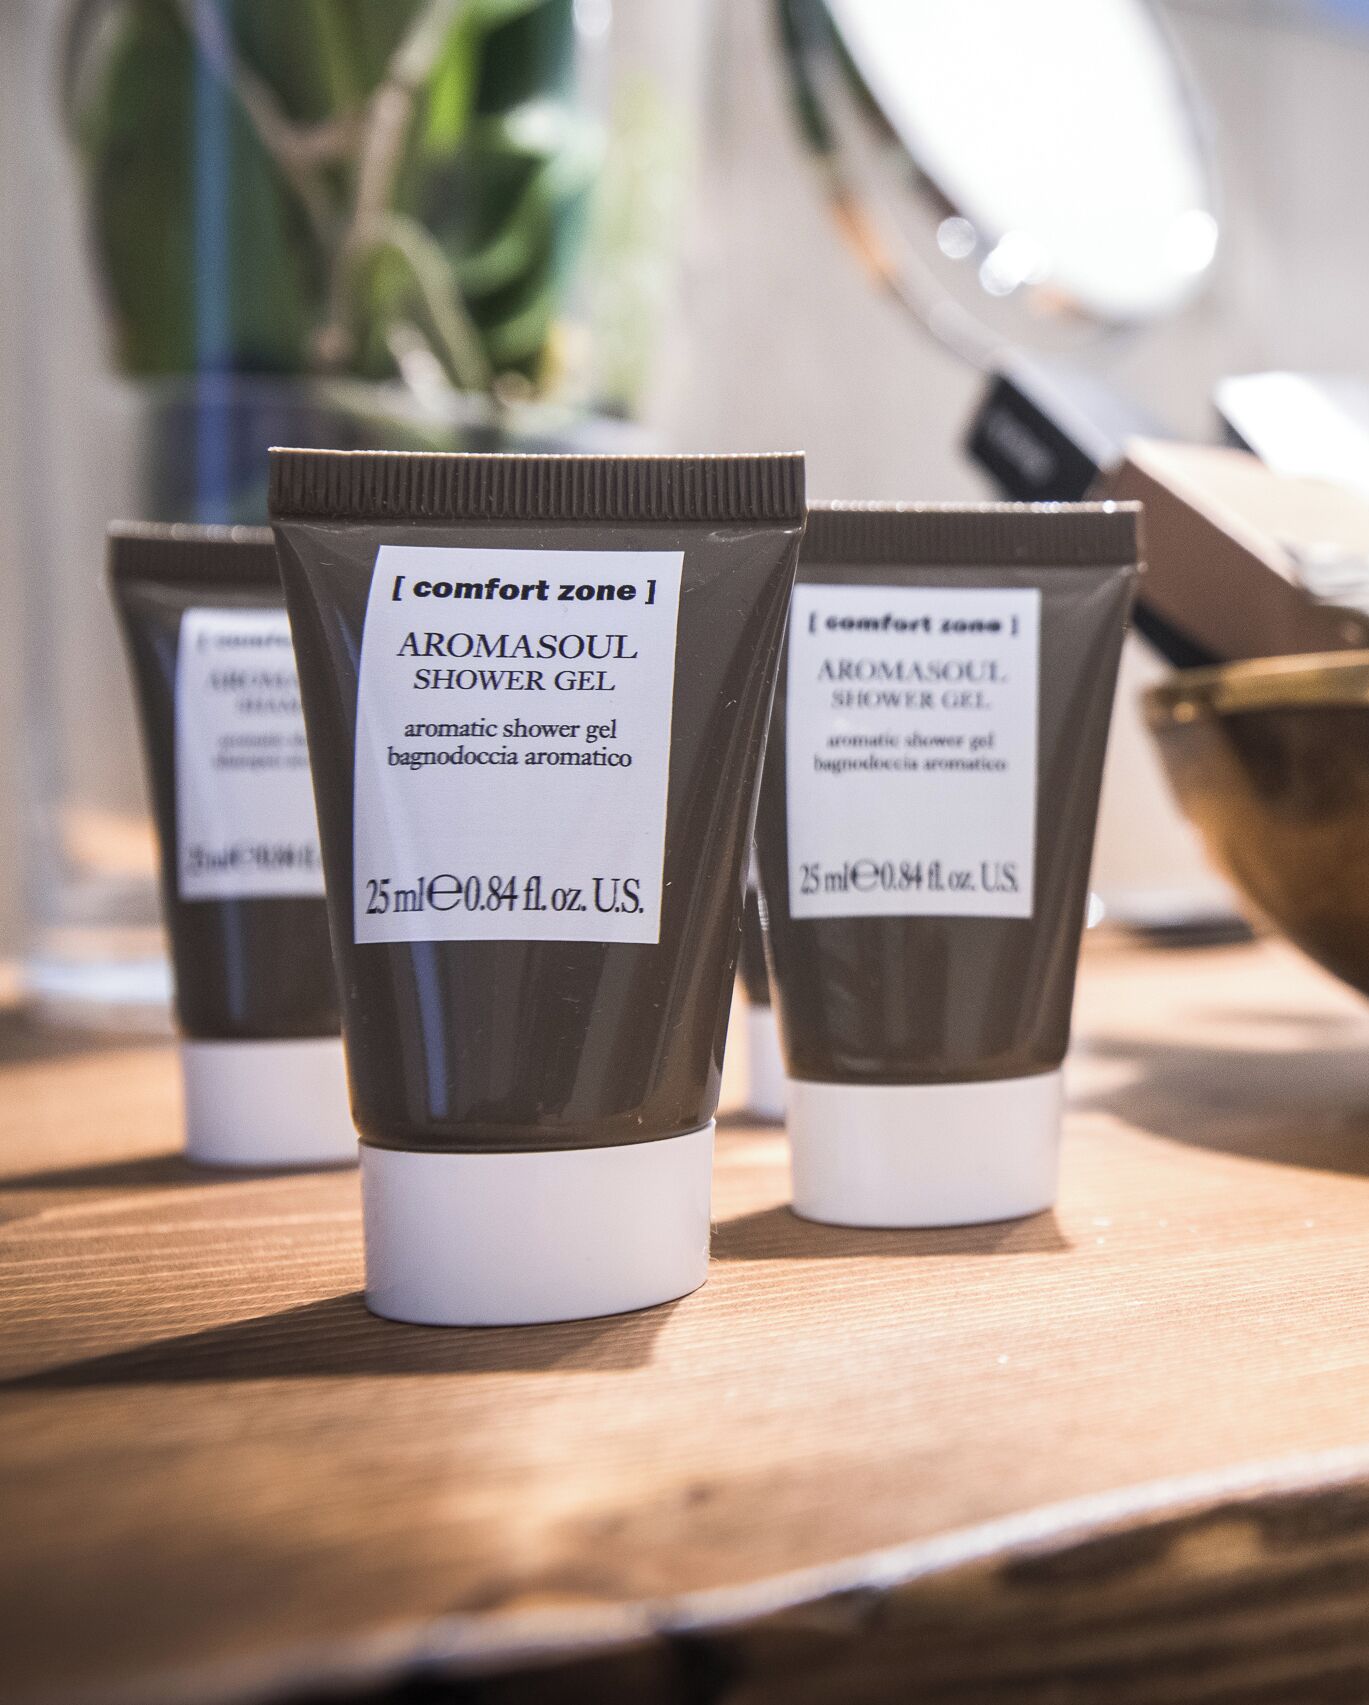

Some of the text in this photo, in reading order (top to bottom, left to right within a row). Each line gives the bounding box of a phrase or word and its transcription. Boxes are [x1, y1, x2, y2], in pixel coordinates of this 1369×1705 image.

[413, 578, 550, 601] comfort
[557, 584, 636, 601] zone
[824, 613, 932, 634] comfort
[397, 632, 638, 659] AROMASOUL
[414, 669, 615, 690] SHOWER GEL
[817, 658, 1007, 684] AROMASOUL
[831, 690, 990, 710] SHOWER GEL
[405, 718, 616, 743] aromatic shower gel
[826, 731, 996, 753] aromatic shower gel
[387, 745, 632, 770] bagnodoccia aromatico
[813, 753, 1007, 775] bagnodoccia aromatico
[800, 863, 821, 896] 25
[366, 879, 390, 914] 25
[522, 876, 547, 911] fl.
[551, 888, 587, 911] oz.
[592, 878, 644, 913] U.S.
